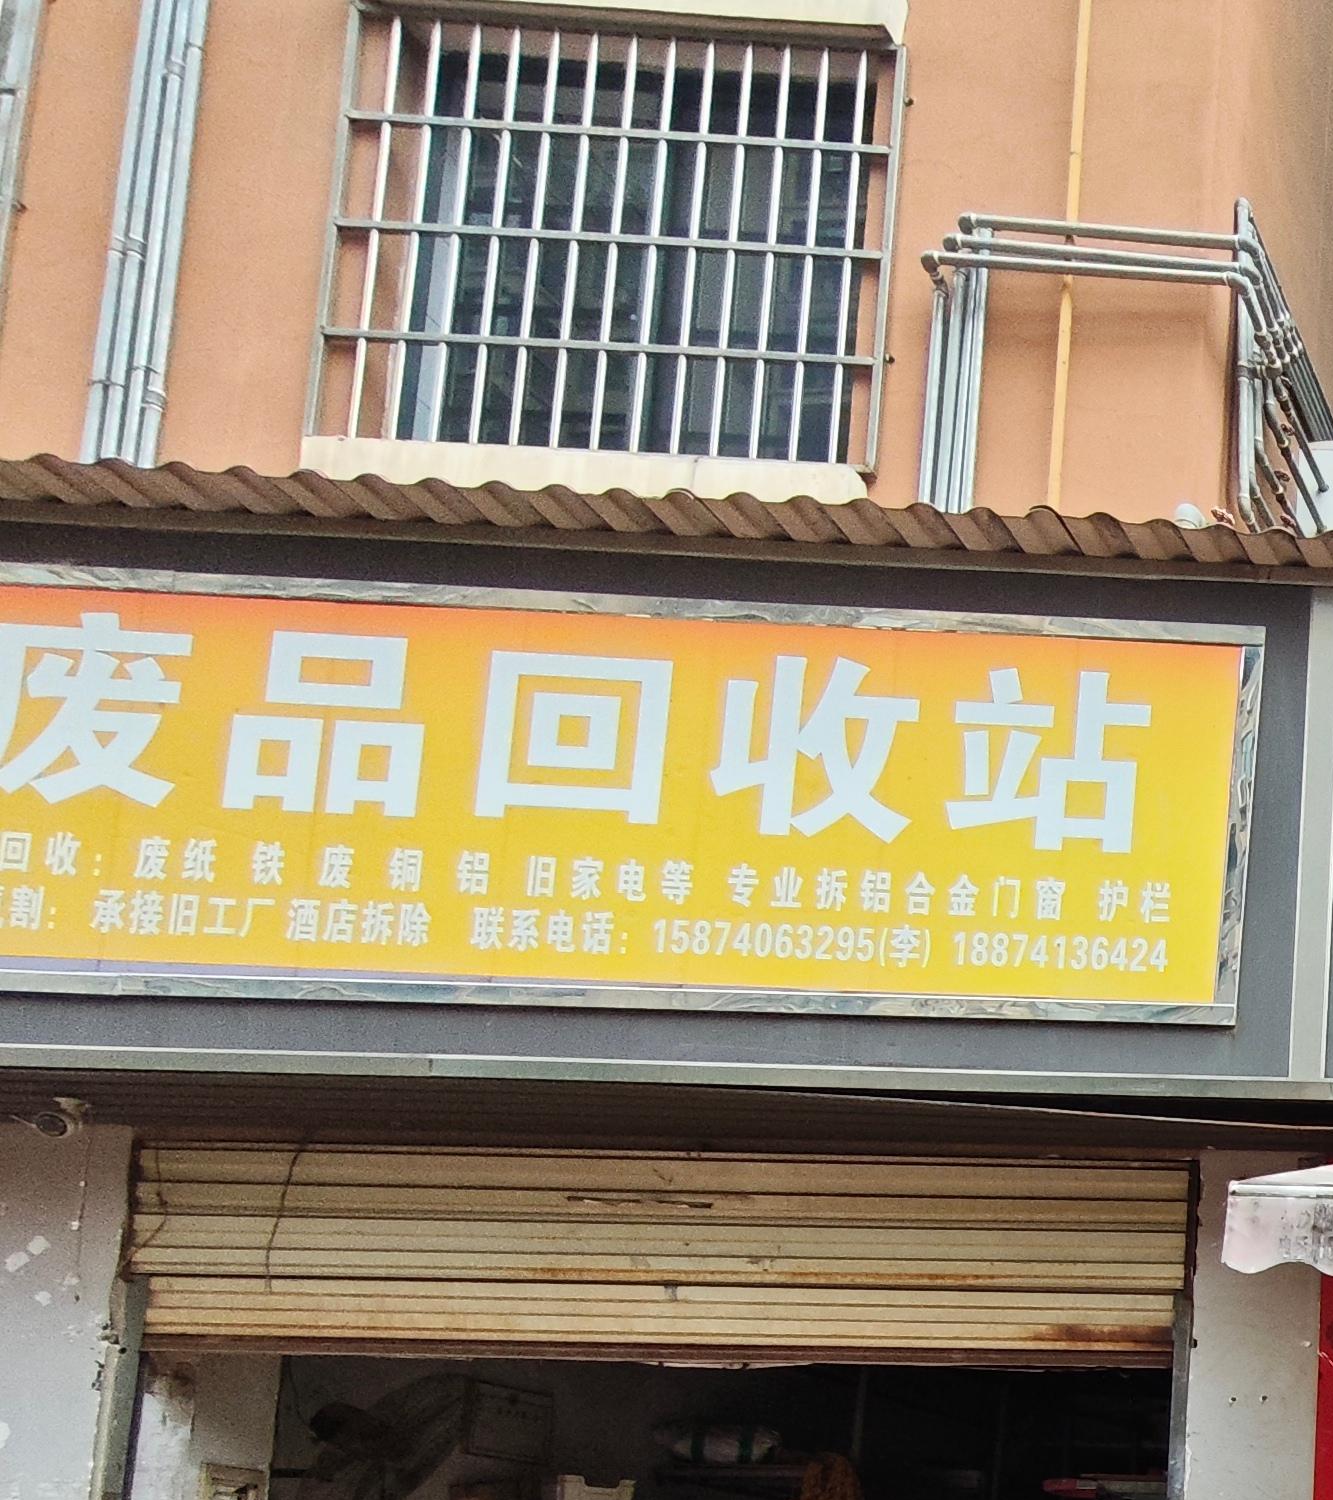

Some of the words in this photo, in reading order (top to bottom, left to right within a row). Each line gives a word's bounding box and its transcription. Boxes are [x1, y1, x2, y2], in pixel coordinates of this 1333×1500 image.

[0, 612, 1152, 853] 废品回收站
[251, 841, 285, 885] 铁
[318, 844, 355, 888] 废
[390, 848, 424, 893] 铜
[456, 851, 490, 895] 铝
[1098, 880, 1171, 924] 护栏
[953, 930, 1169, 973] 18874136424
